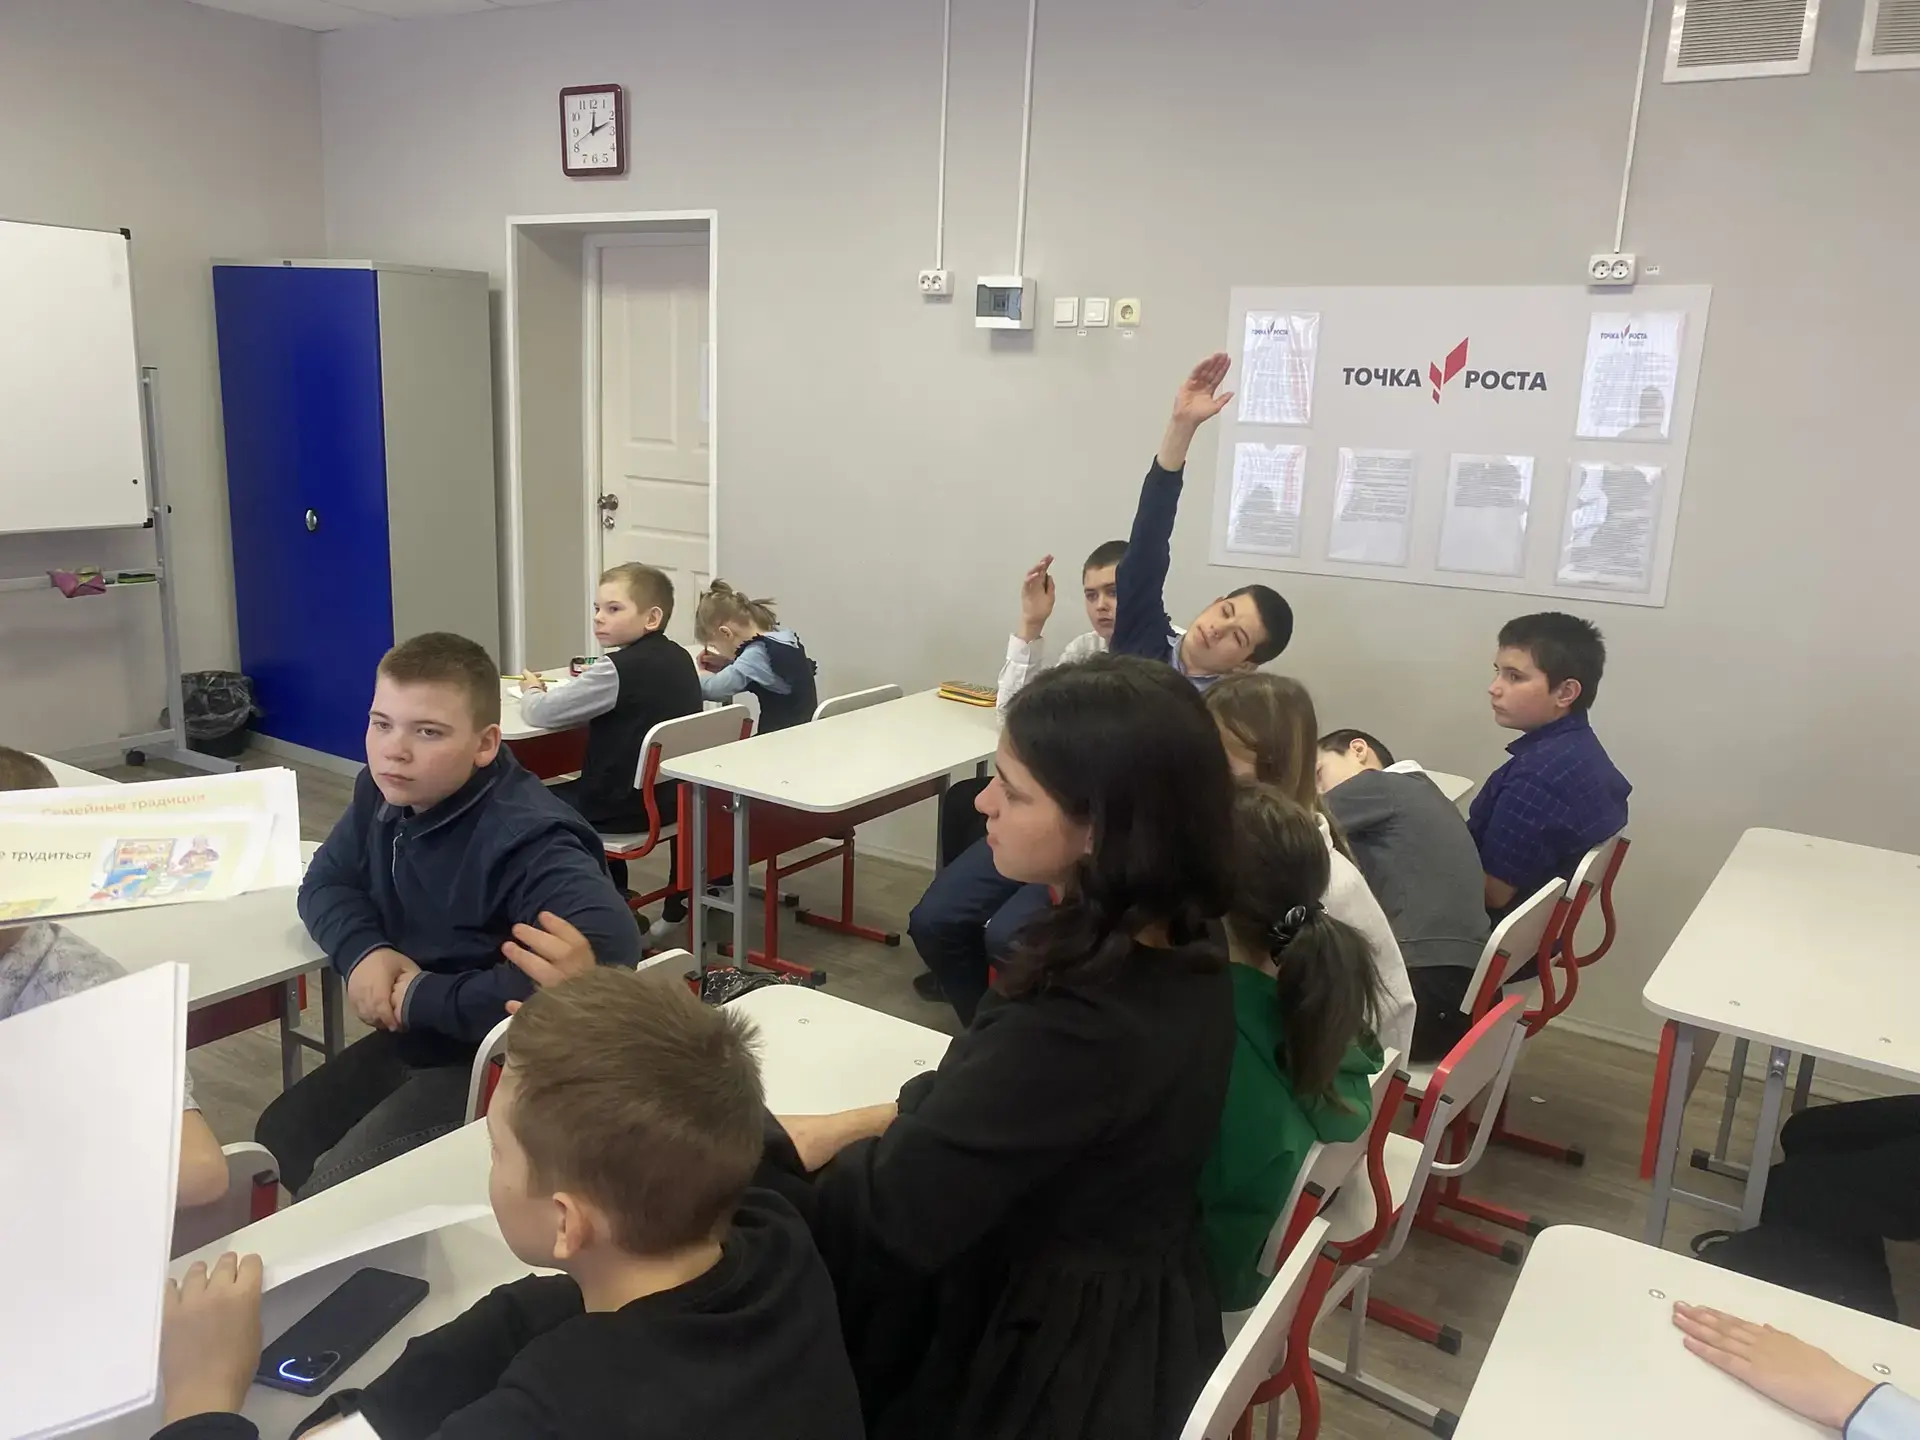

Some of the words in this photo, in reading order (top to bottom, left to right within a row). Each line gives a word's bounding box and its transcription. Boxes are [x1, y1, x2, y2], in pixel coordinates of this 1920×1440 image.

[579, 100, 586, 110] 11
[589, 99, 597, 109] 12
[572, 112, 580, 122] 10
[609, 111, 615, 120] 2
[573, 127, 579, 137] 9
[609, 126, 615, 136] 3
[573, 143, 580, 153] 8
[609, 143, 615, 152] 4
[582, 153, 587, 163] 7
[591, 153, 598, 163] 6
[602, 153, 608, 163] 5
[1343, 367, 1422, 387] ТОЧКА
[1464, 370, 1547, 391] РОСТА
[12, 851, 92, 862] трудиться
